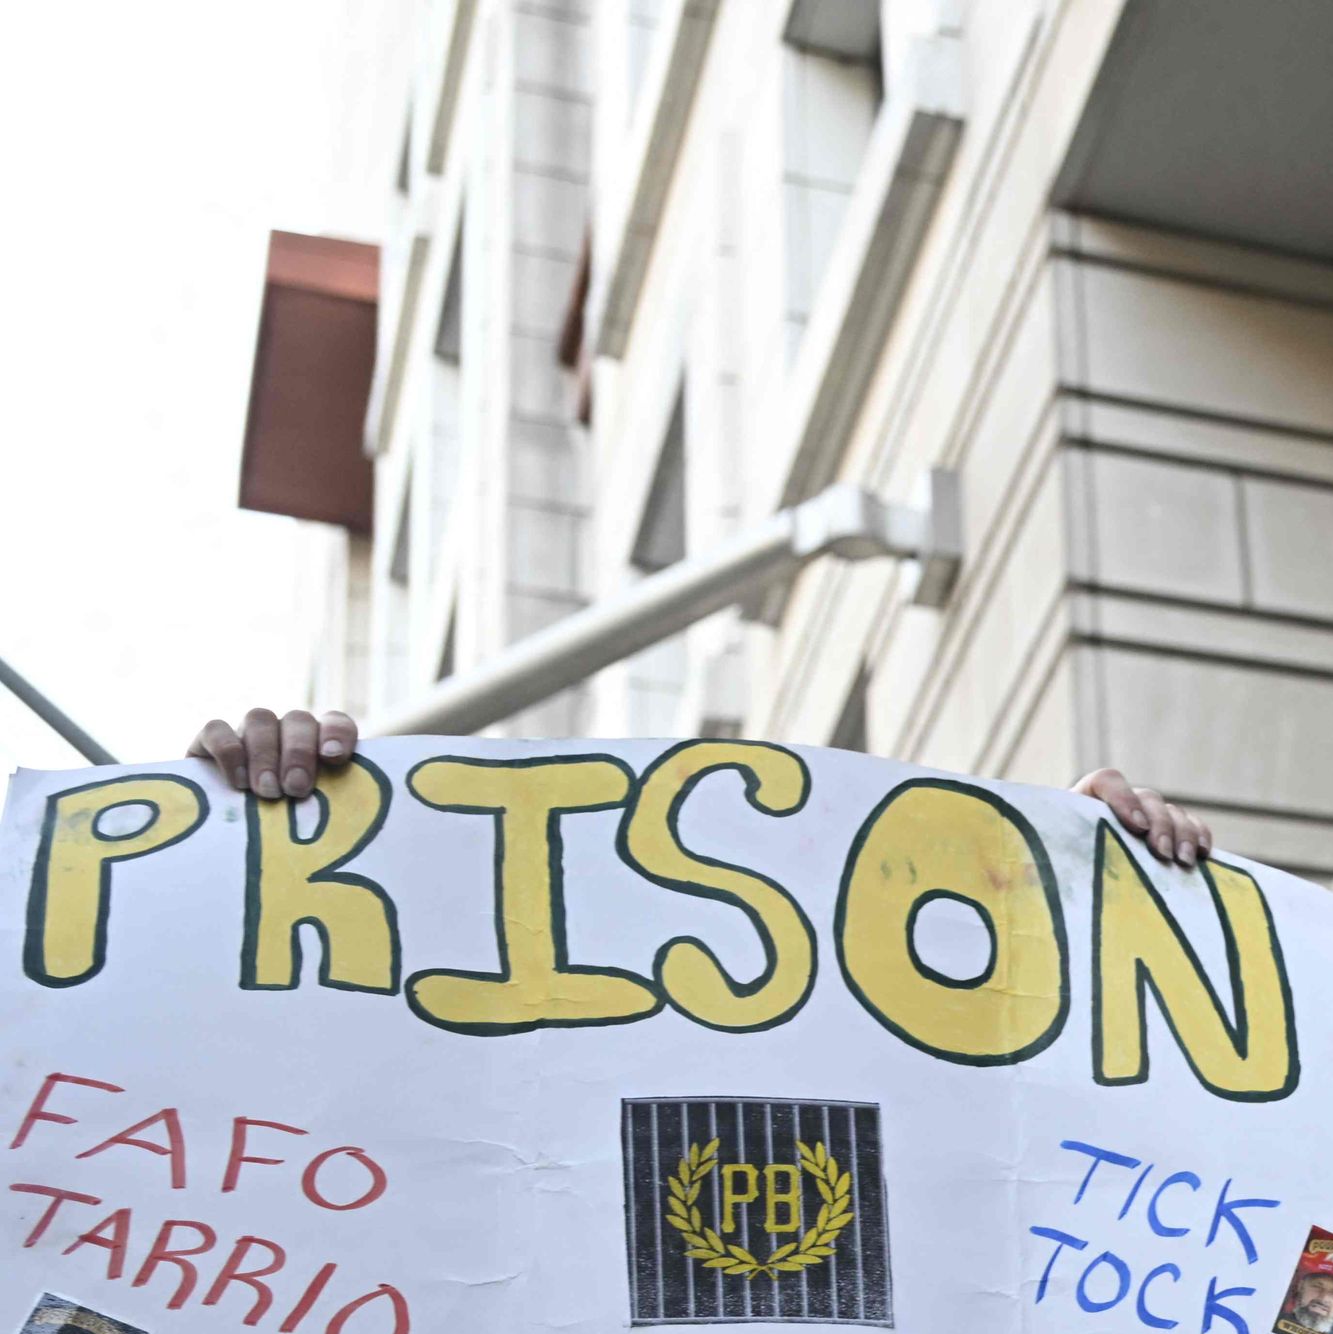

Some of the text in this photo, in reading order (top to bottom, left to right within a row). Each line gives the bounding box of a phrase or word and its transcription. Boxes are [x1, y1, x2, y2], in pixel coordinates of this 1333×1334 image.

[23, 738, 1301, 1103] PRISON
[9, 1072, 387, 1211] FAFO
[721, 1164, 802, 1233] PB
[1060, 1139, 1281, 1265] TICK
